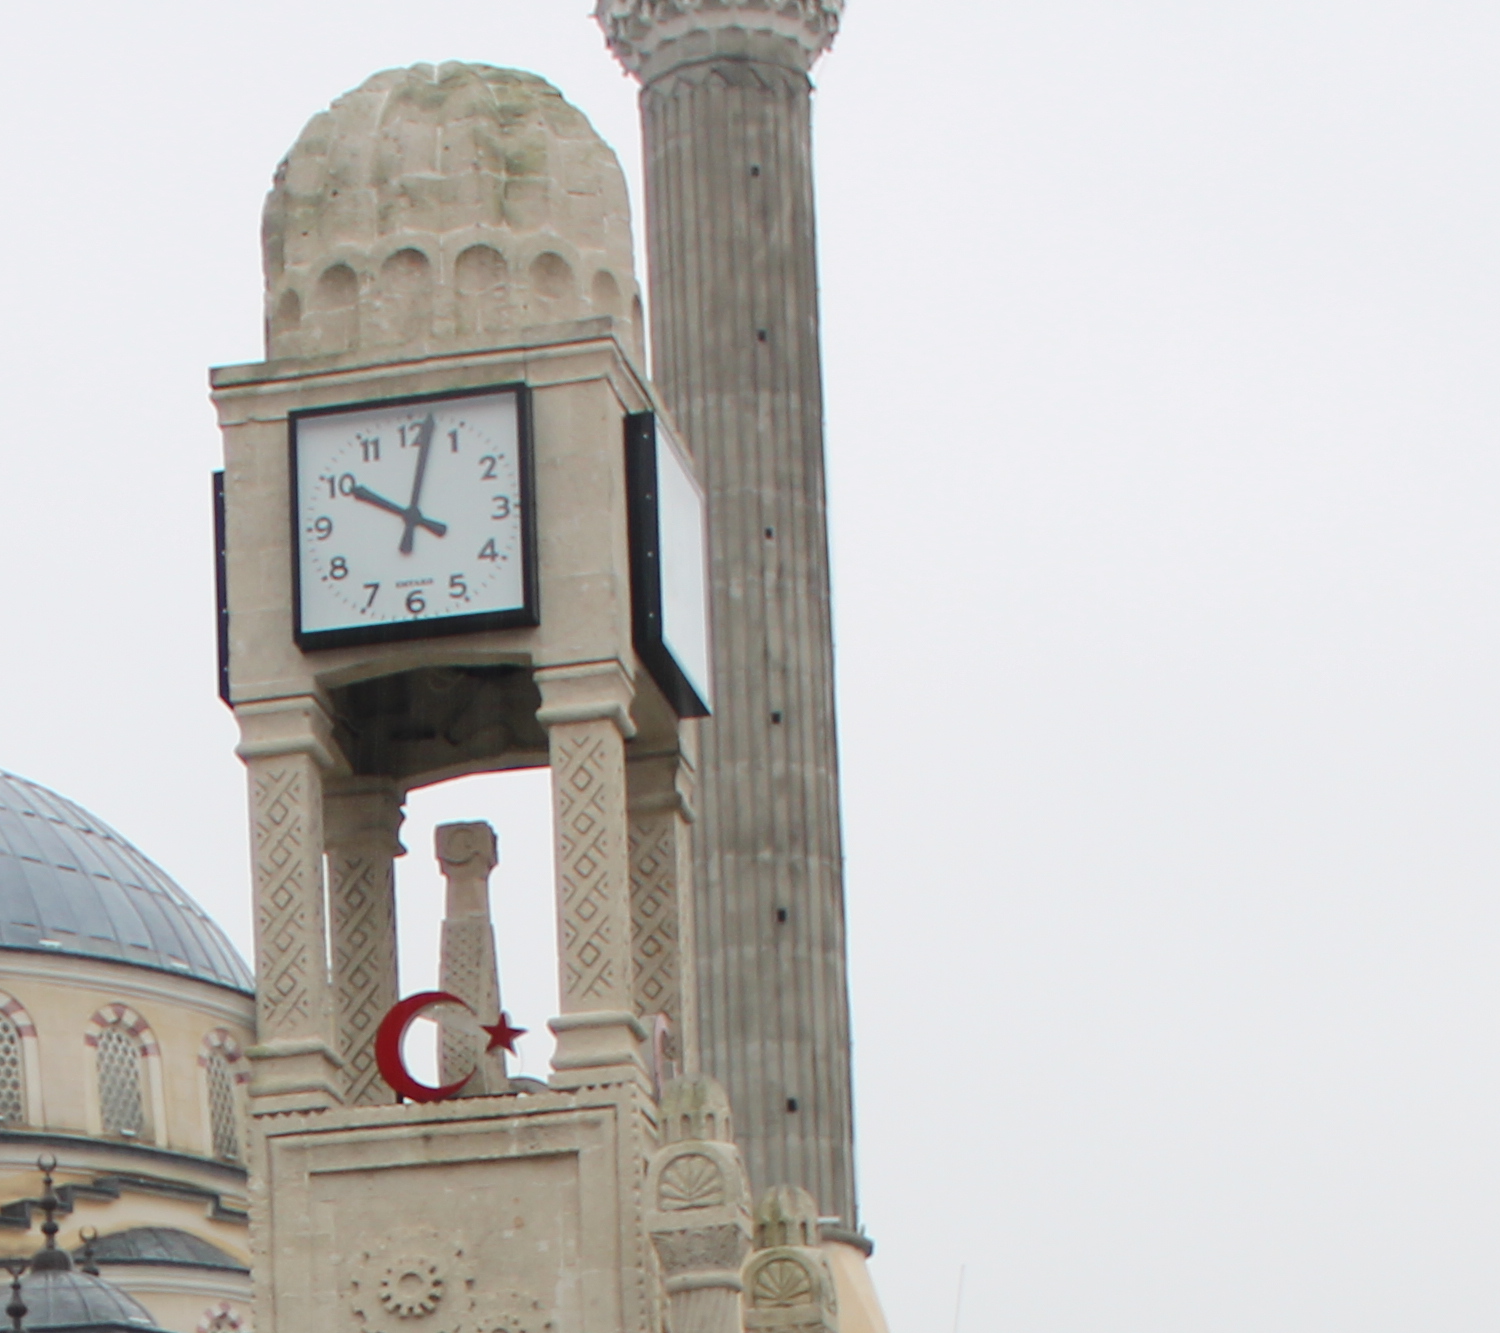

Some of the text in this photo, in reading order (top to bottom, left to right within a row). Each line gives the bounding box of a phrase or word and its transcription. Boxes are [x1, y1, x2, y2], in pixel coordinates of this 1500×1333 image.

[360, 437, 380, 462] 11
[447, 428, 458, 452] 1
[478, 455, 498, 480] 2
[327, 472, 356, 499] 10
[491, 495, 510, 520] 3
[314, 516, 333, 541] 9
[477, 538, 499, 562] 4
[329, 556, 349, 580] 8
[362, 582, 381, 608] 7
[448, 573, 468, 598] 5
[405, 589, 426, 614] 6
